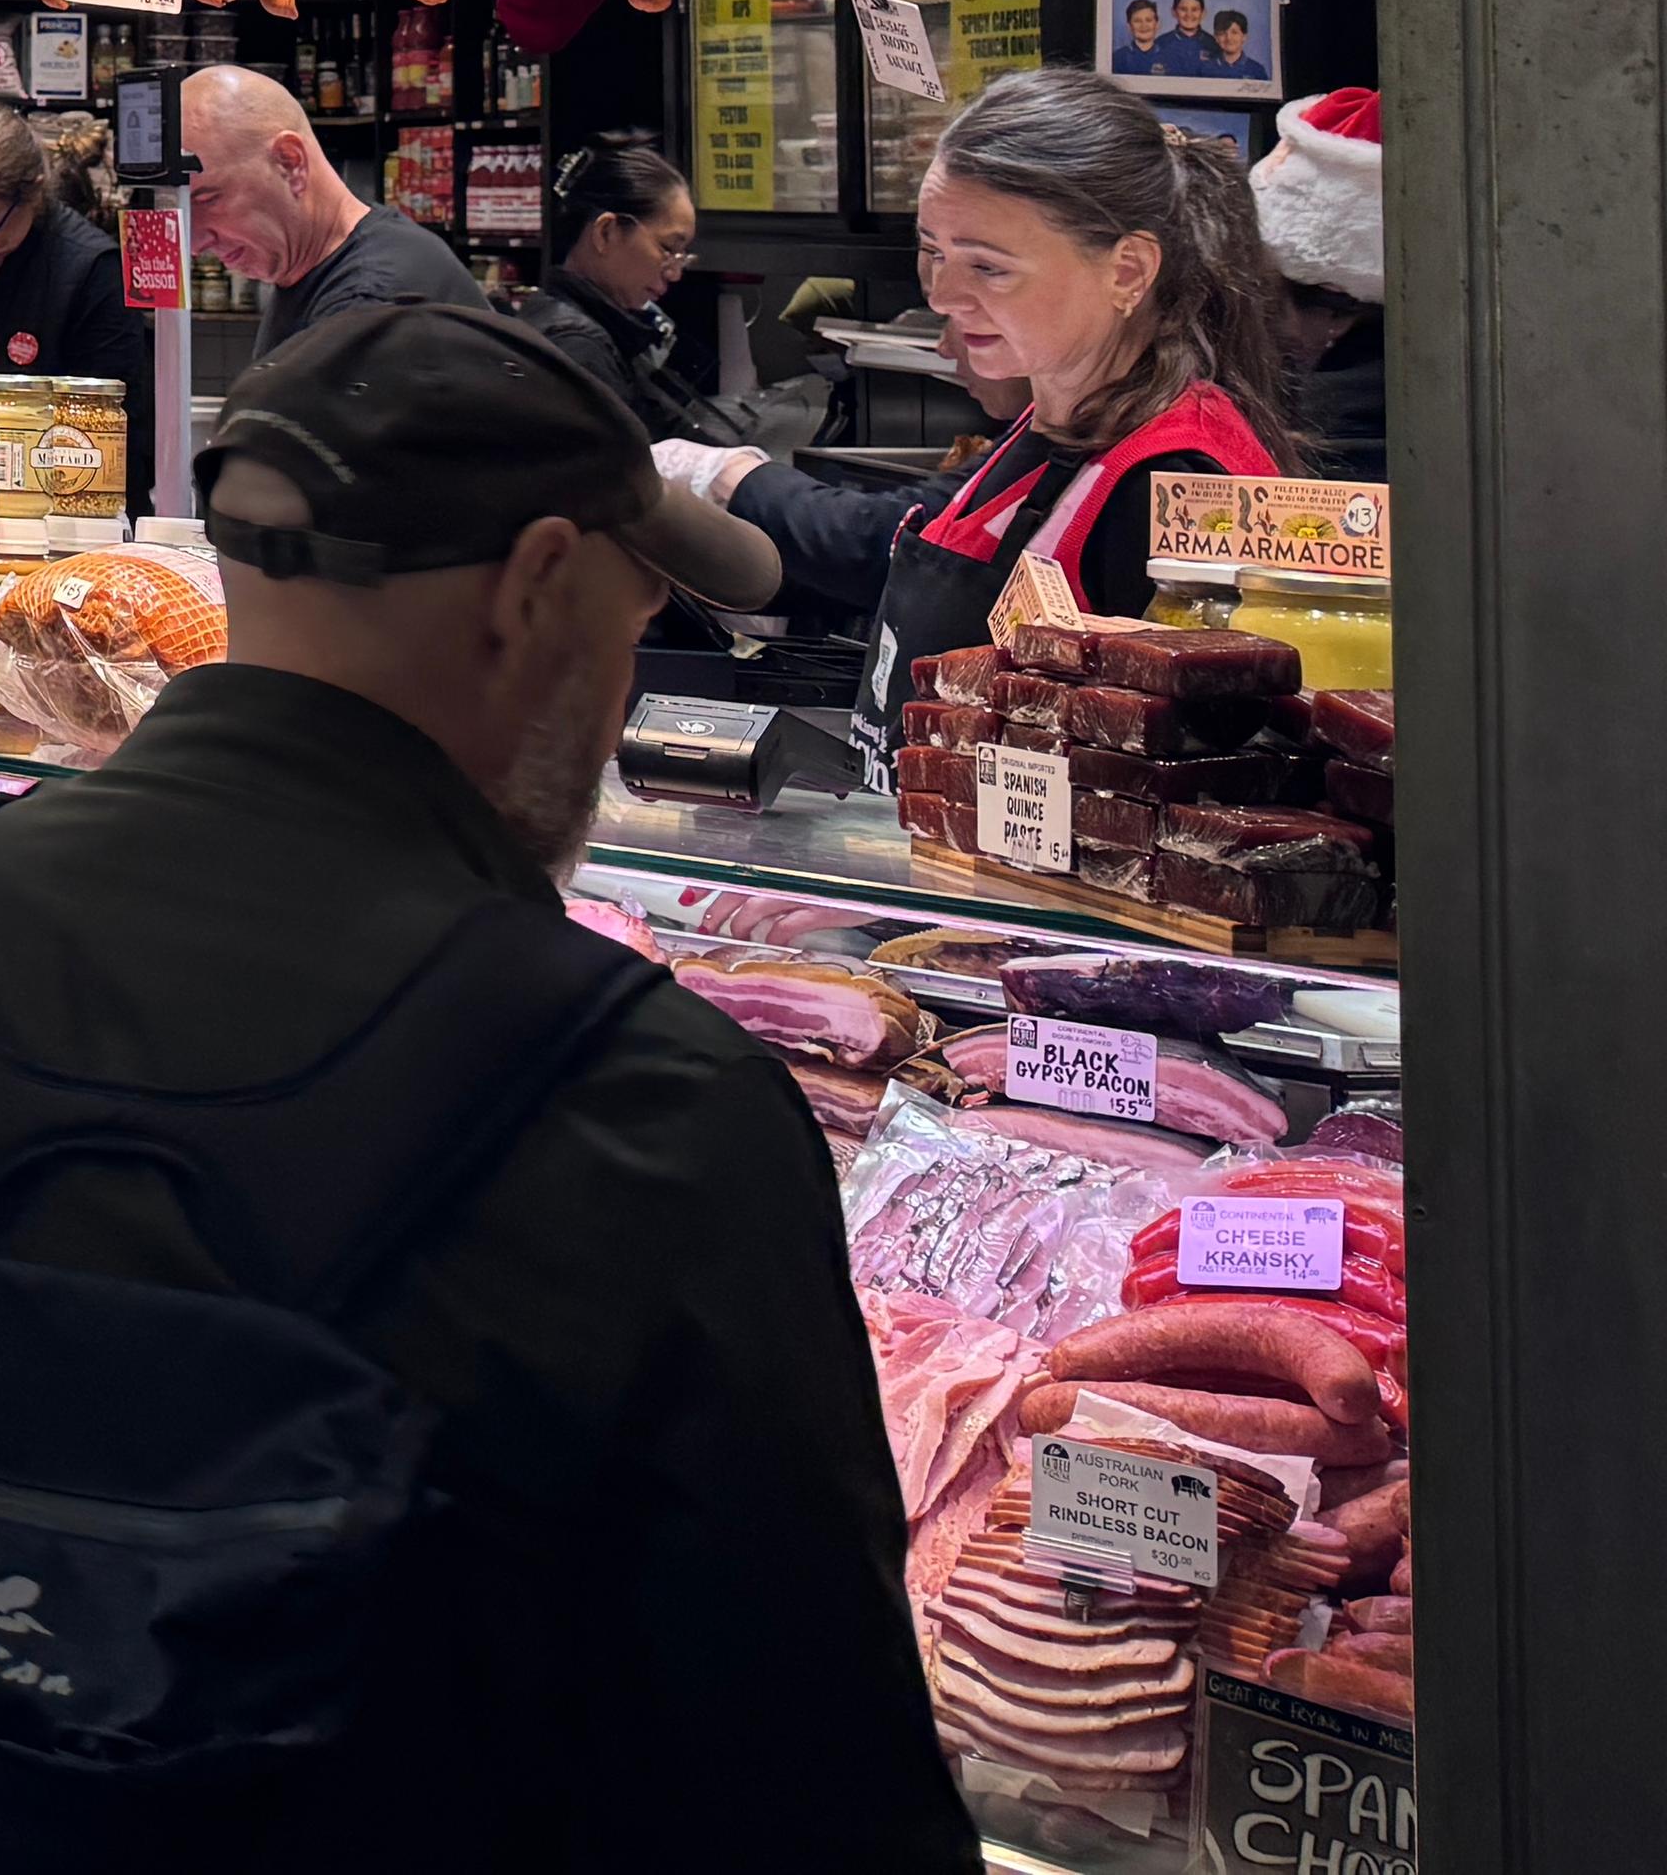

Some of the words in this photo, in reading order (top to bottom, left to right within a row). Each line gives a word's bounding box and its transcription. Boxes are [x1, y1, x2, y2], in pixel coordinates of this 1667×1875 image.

[132, 265, 178, 291] Season
[1155, 530, 1233, 557] ARMA
[1238, 536, 1385, 570] ARMATORE
[1003, 770, 1048, 798] SPANISH
[1007, 795, 1045, 822] QUINCE
[1003, 820, 1043, 852] PASTE
[1057, 1024, 1108, 1039] CONTINENTAL
[1043, 1043, 1120, 1075] BLACK
[1016, 1060, 1079, 1086] GYPSY
[1084, 1071, 1151, 1099] BACON
[1220, 1209, 1296, 1222] CONTINENTAL
[1216, 1229, 1307, 1247] CHEESE
[1197, 1264, 1227, 1274] TASTY
[1228, 1265, 1268, 1276] CHEESE
[1205, 1250, 1316, 1269] KRANSKY
[1074, 1452, 1164, 1482] AUSTRALIAN
[1098, 1472, 1140, 1493] PORK
[1076, 1490, 1139, 1517] SHORT
[1143, 1505, 1181, 1527] CUT
[1049, 1503, 1139, 1537] RINDLESS
[1143, 1524, 1209, 1554] BACON
[1207, 1674, 1254, 1704] GREAT
[1257, 1690, 1285, 1714] FOR
[1289, 1701, 1343, 1735] FRYING
